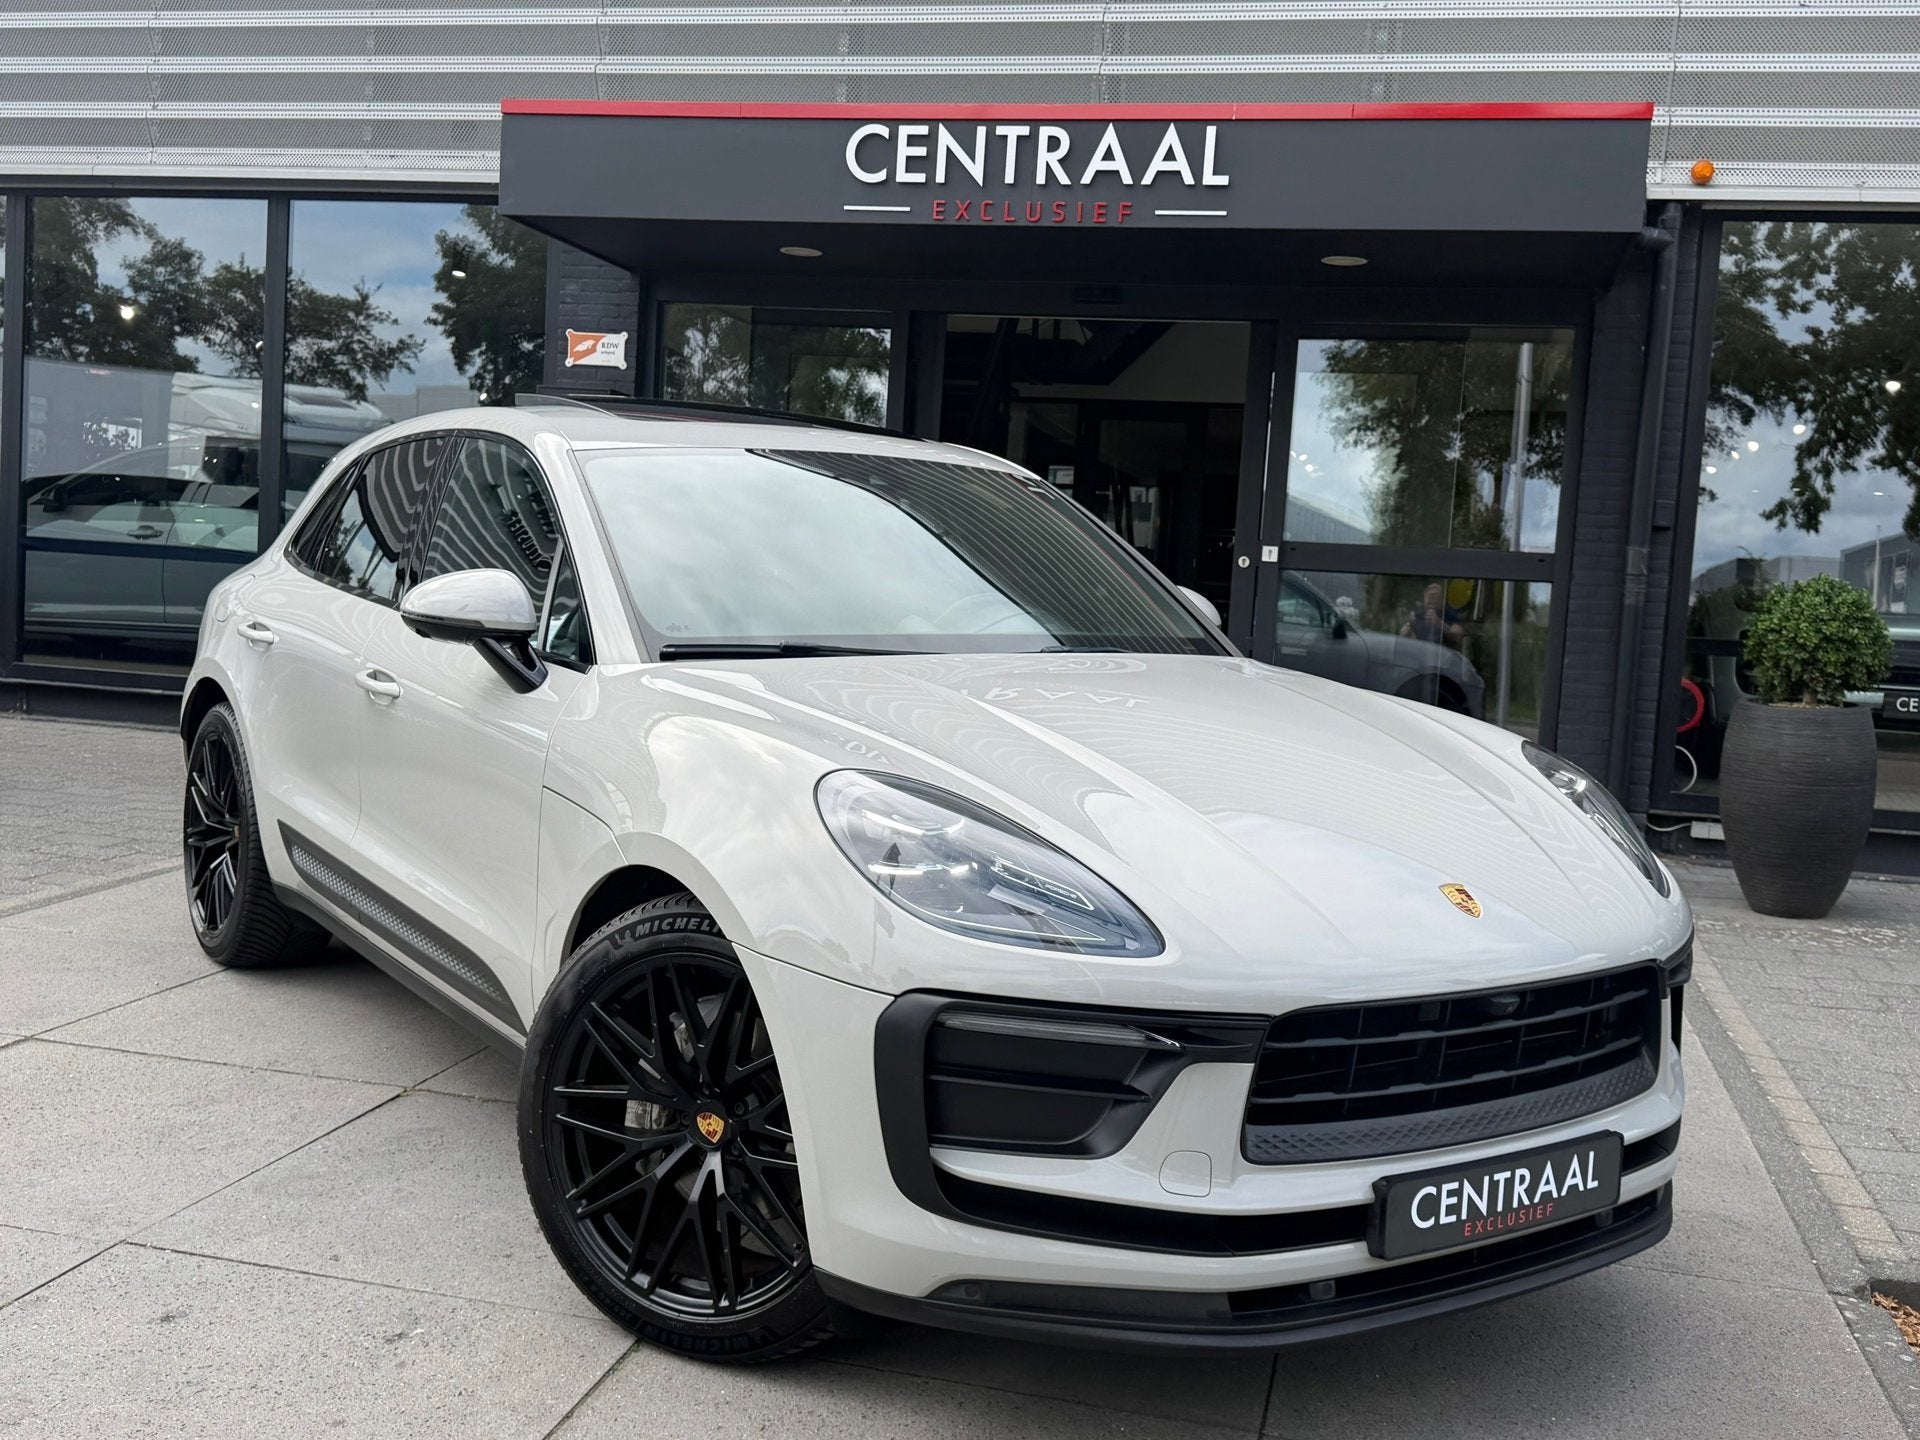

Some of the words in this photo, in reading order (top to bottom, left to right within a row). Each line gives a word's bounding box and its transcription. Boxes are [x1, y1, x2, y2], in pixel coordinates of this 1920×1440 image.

[845, 122, 1230, 188] CENTRAAL
[932, 199, 1134, 224] EXCLUSIEF
[1896, 697, 1920, 712] CE
[1045, 883, 1077, 898] PORSCHE
[635, 917, 722, 937] MICHELI
[1410, 1150, 1599, 1229] CENTRAAL
[1464, 1203, 1554, 1236] EXCLUSIEF
